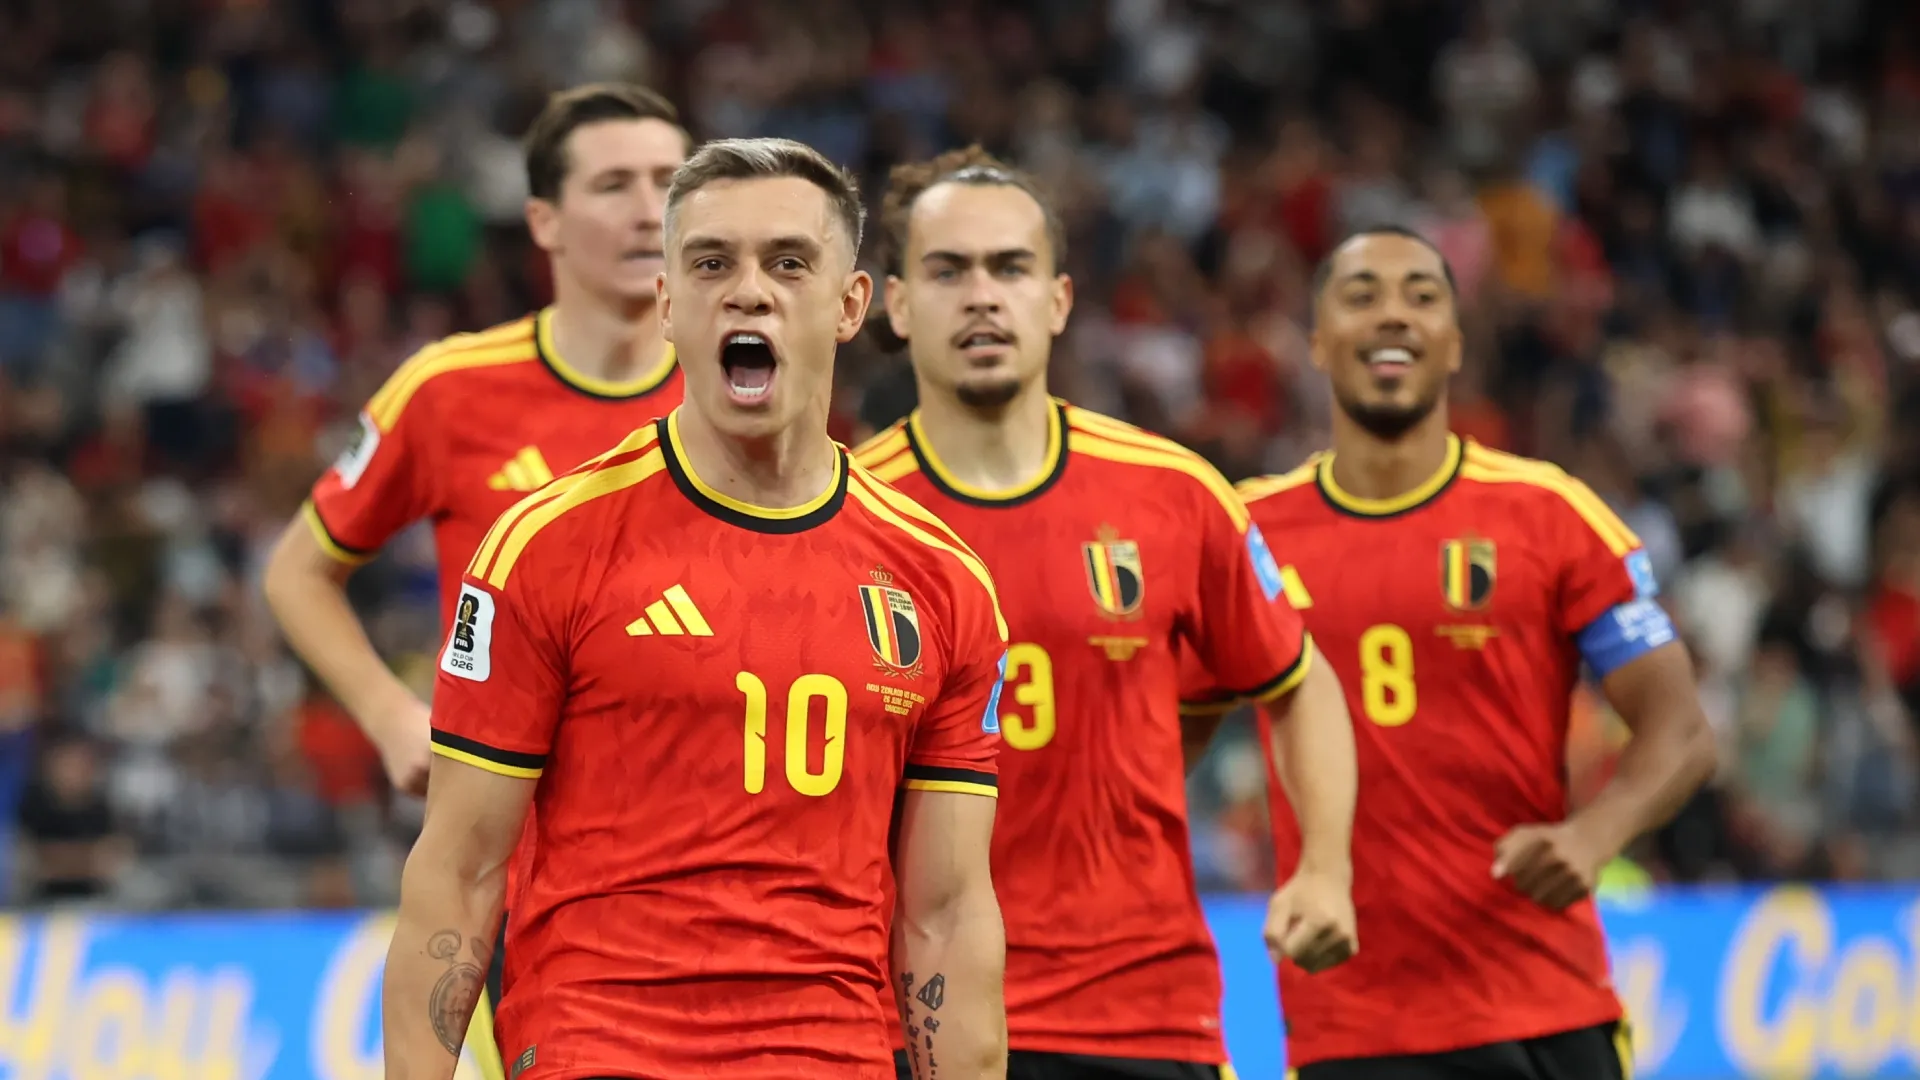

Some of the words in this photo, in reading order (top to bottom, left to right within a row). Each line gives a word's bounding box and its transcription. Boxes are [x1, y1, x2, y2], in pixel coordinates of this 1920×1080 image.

[450, 658, 474, 671] 026
[456, 638, 469, 648] FIFA
[1358, 623, 1418, 727] 8
[735, 671, 848, 796] 10
[1001, 643, 1057, 750] 3
